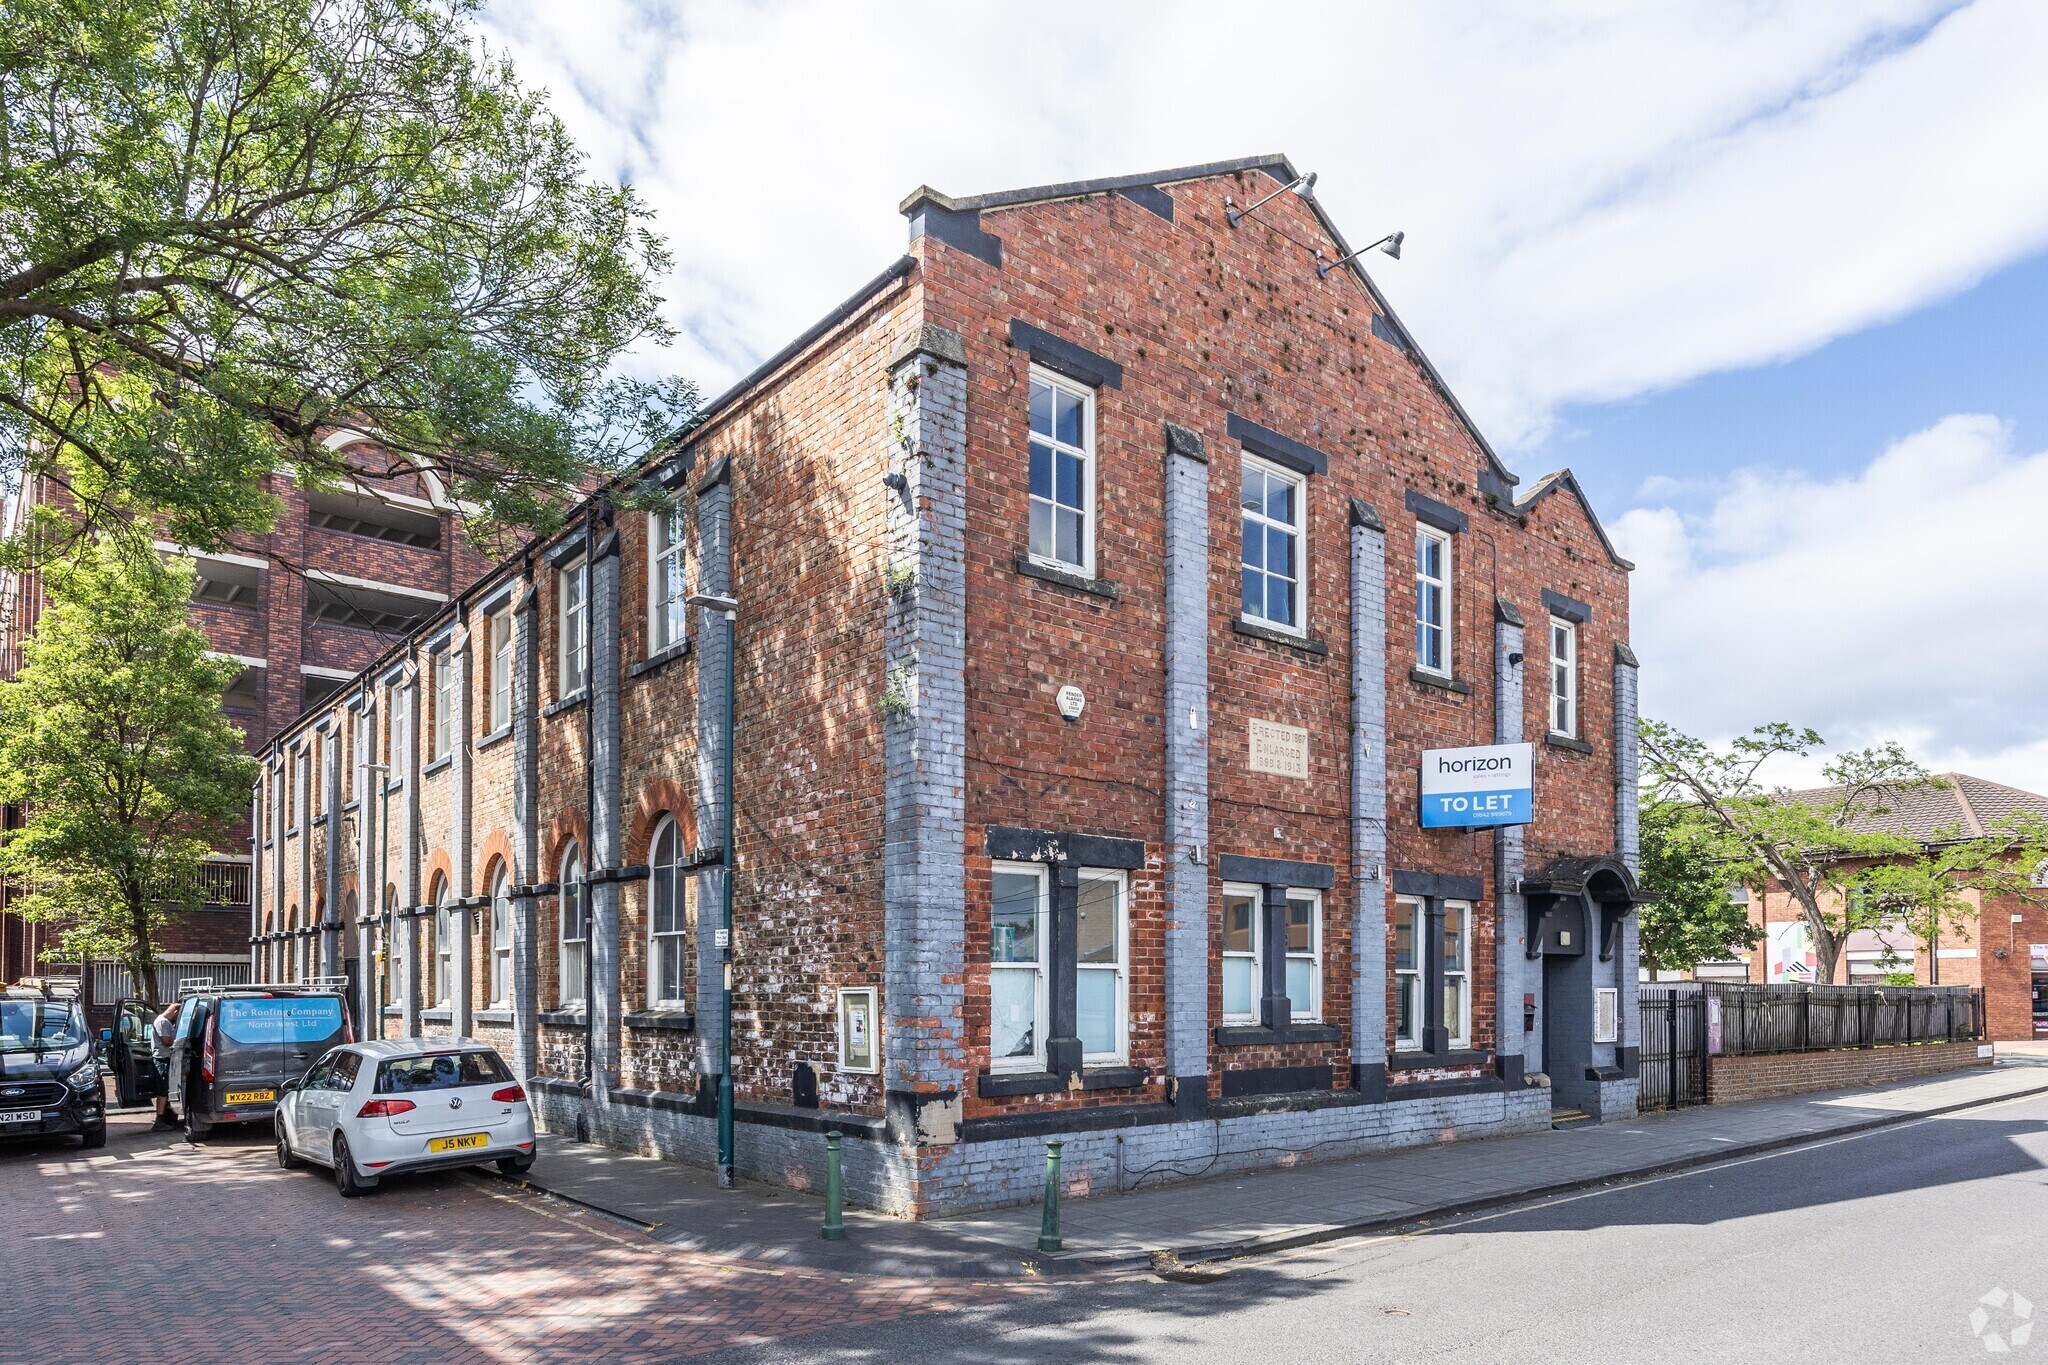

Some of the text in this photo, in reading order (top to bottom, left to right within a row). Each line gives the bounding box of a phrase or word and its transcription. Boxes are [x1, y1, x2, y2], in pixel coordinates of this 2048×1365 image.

[1252, 723, 1290, 741] ERECTED
[1256, 739, 1300, 759] ENLARGED
[1256, 756, 1274, 768] 1889
[1440, 757, 1511, 773] horizon
[1440, 794, 1512, 812] TO LET
[251, 1008, 291, 1018] Roofing
[292, 1008, 333, 1016] Company
[442, 1136, 477, 1150] J5 NKV
